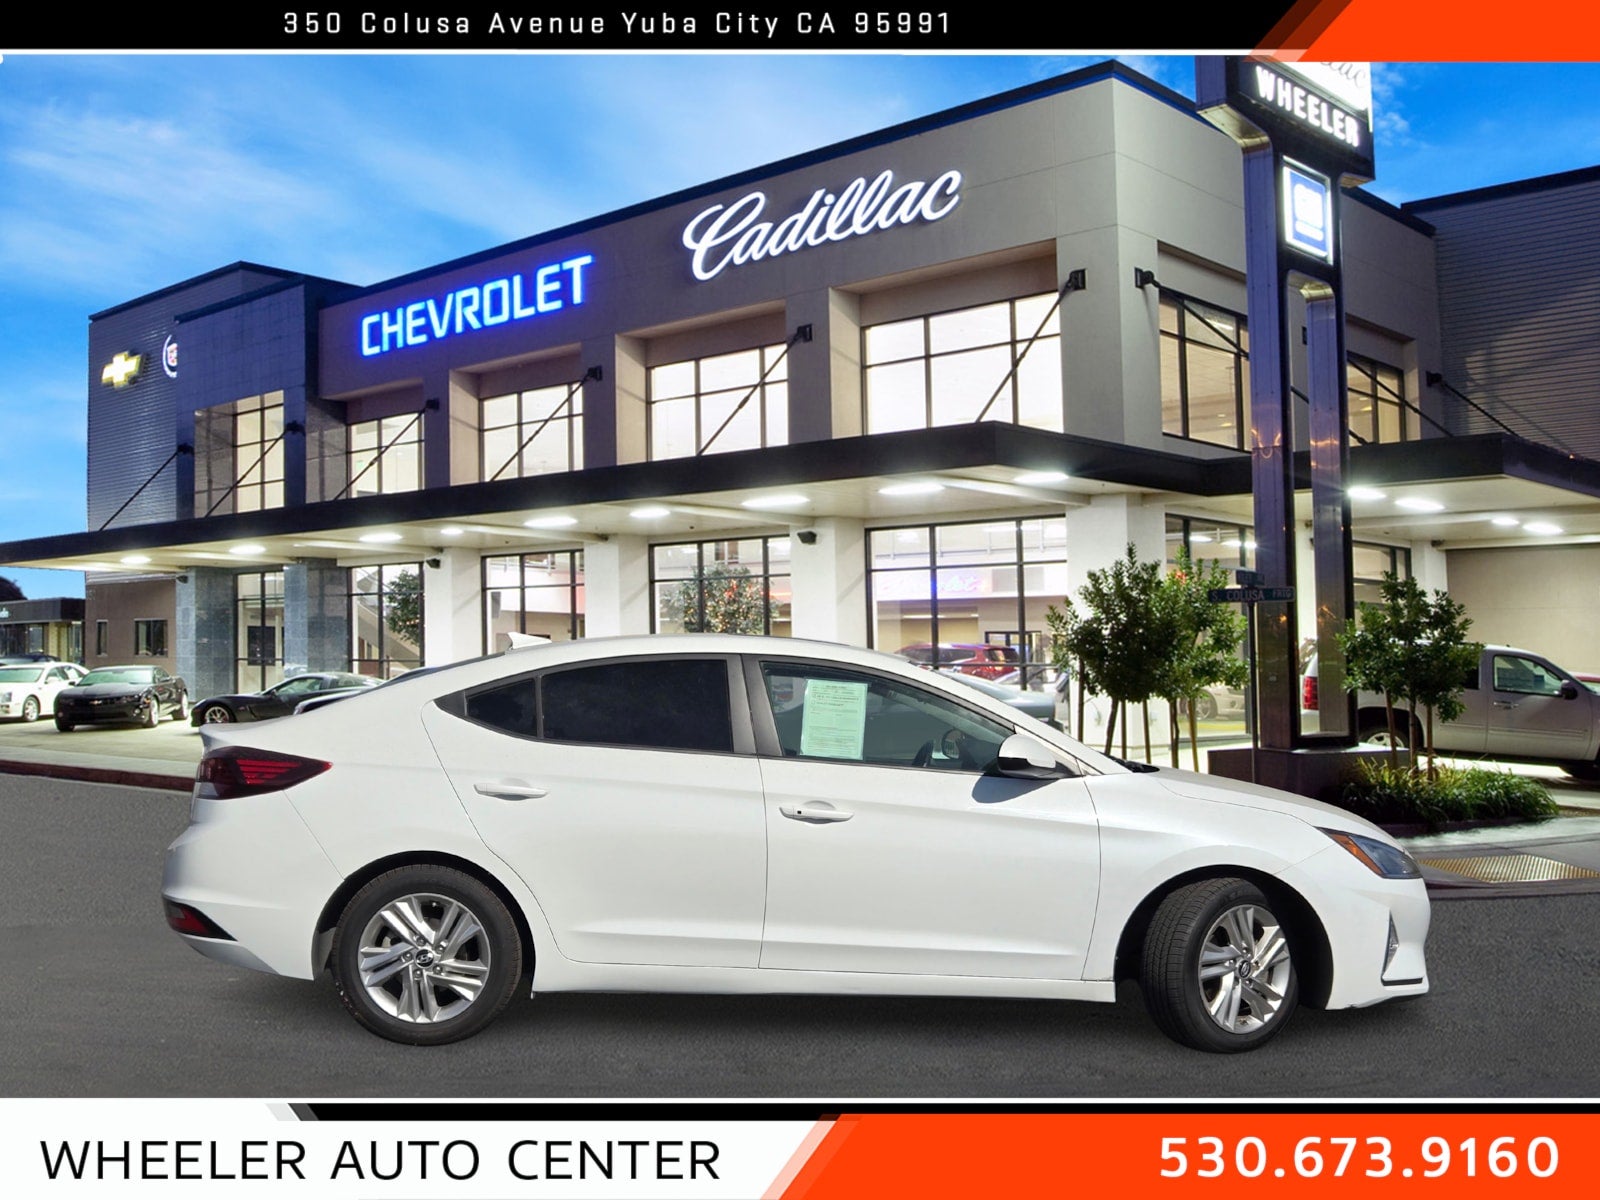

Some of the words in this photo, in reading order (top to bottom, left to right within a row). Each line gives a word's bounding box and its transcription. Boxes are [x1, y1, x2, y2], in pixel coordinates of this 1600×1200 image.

[1254, 65, 1360, 148] WHEELER
[682, 169, 964, 282] Cadillac
[361, 254, 595, 358] CHEVROLET
[1226, 589, 1265, 602] COLUSA
